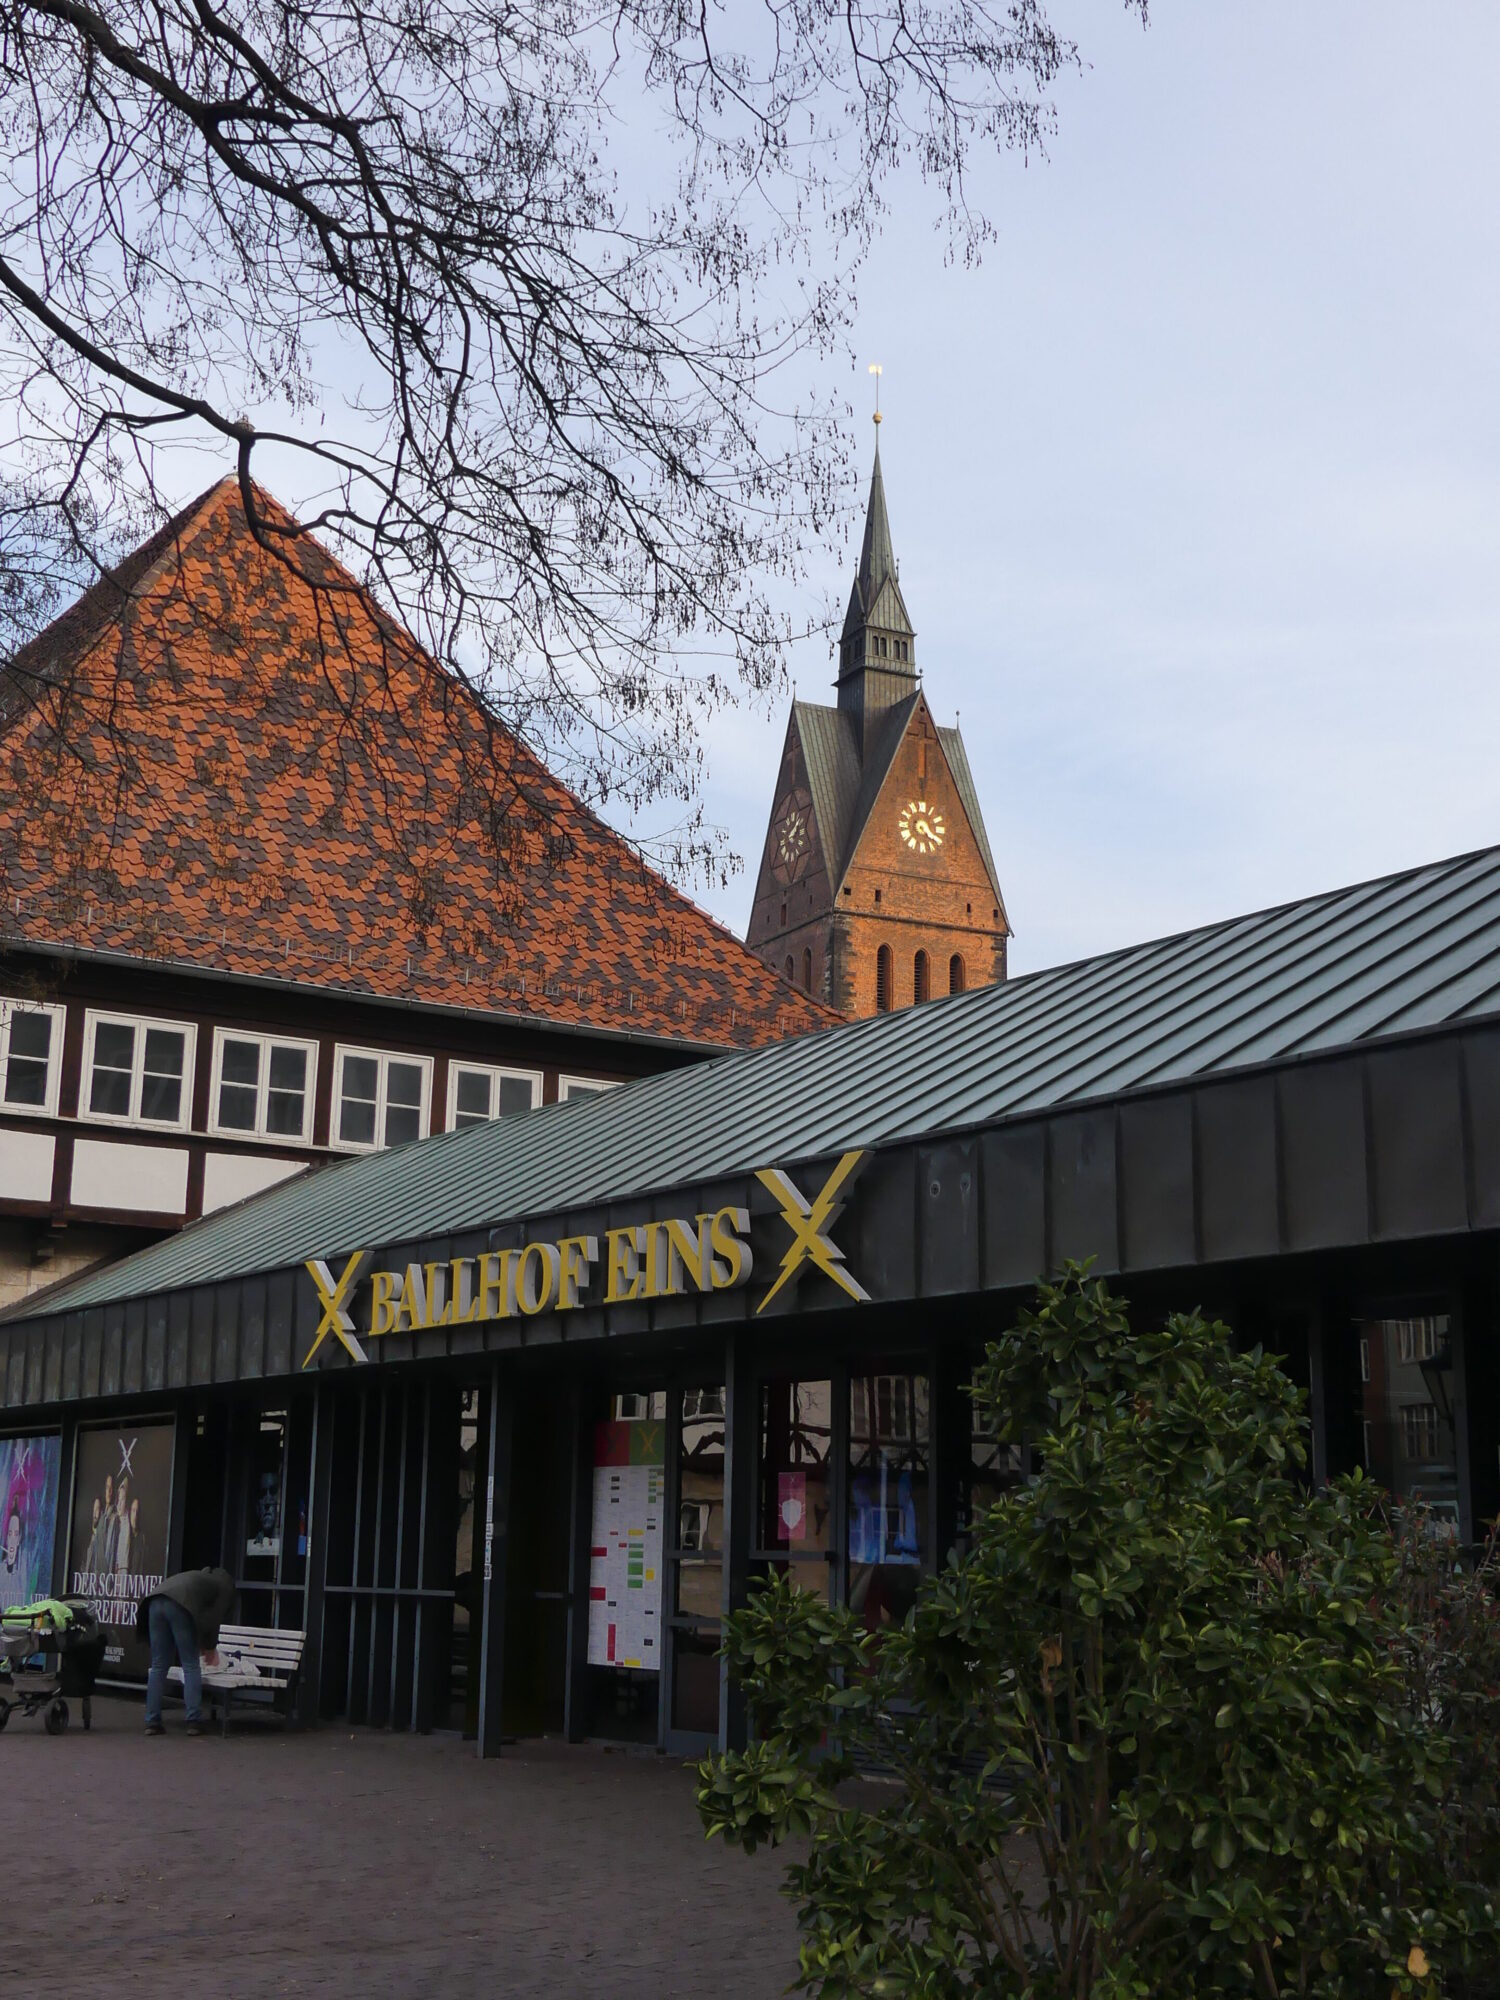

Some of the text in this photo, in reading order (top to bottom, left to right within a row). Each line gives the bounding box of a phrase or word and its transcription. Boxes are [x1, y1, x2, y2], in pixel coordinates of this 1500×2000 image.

[368, 1236, 599, 1336] BALLHOF
[603, 1206, 753, 1303] EINS
[73, 1571, 97, 1596] DER
[94, 1599, 138, 1626] REITER
